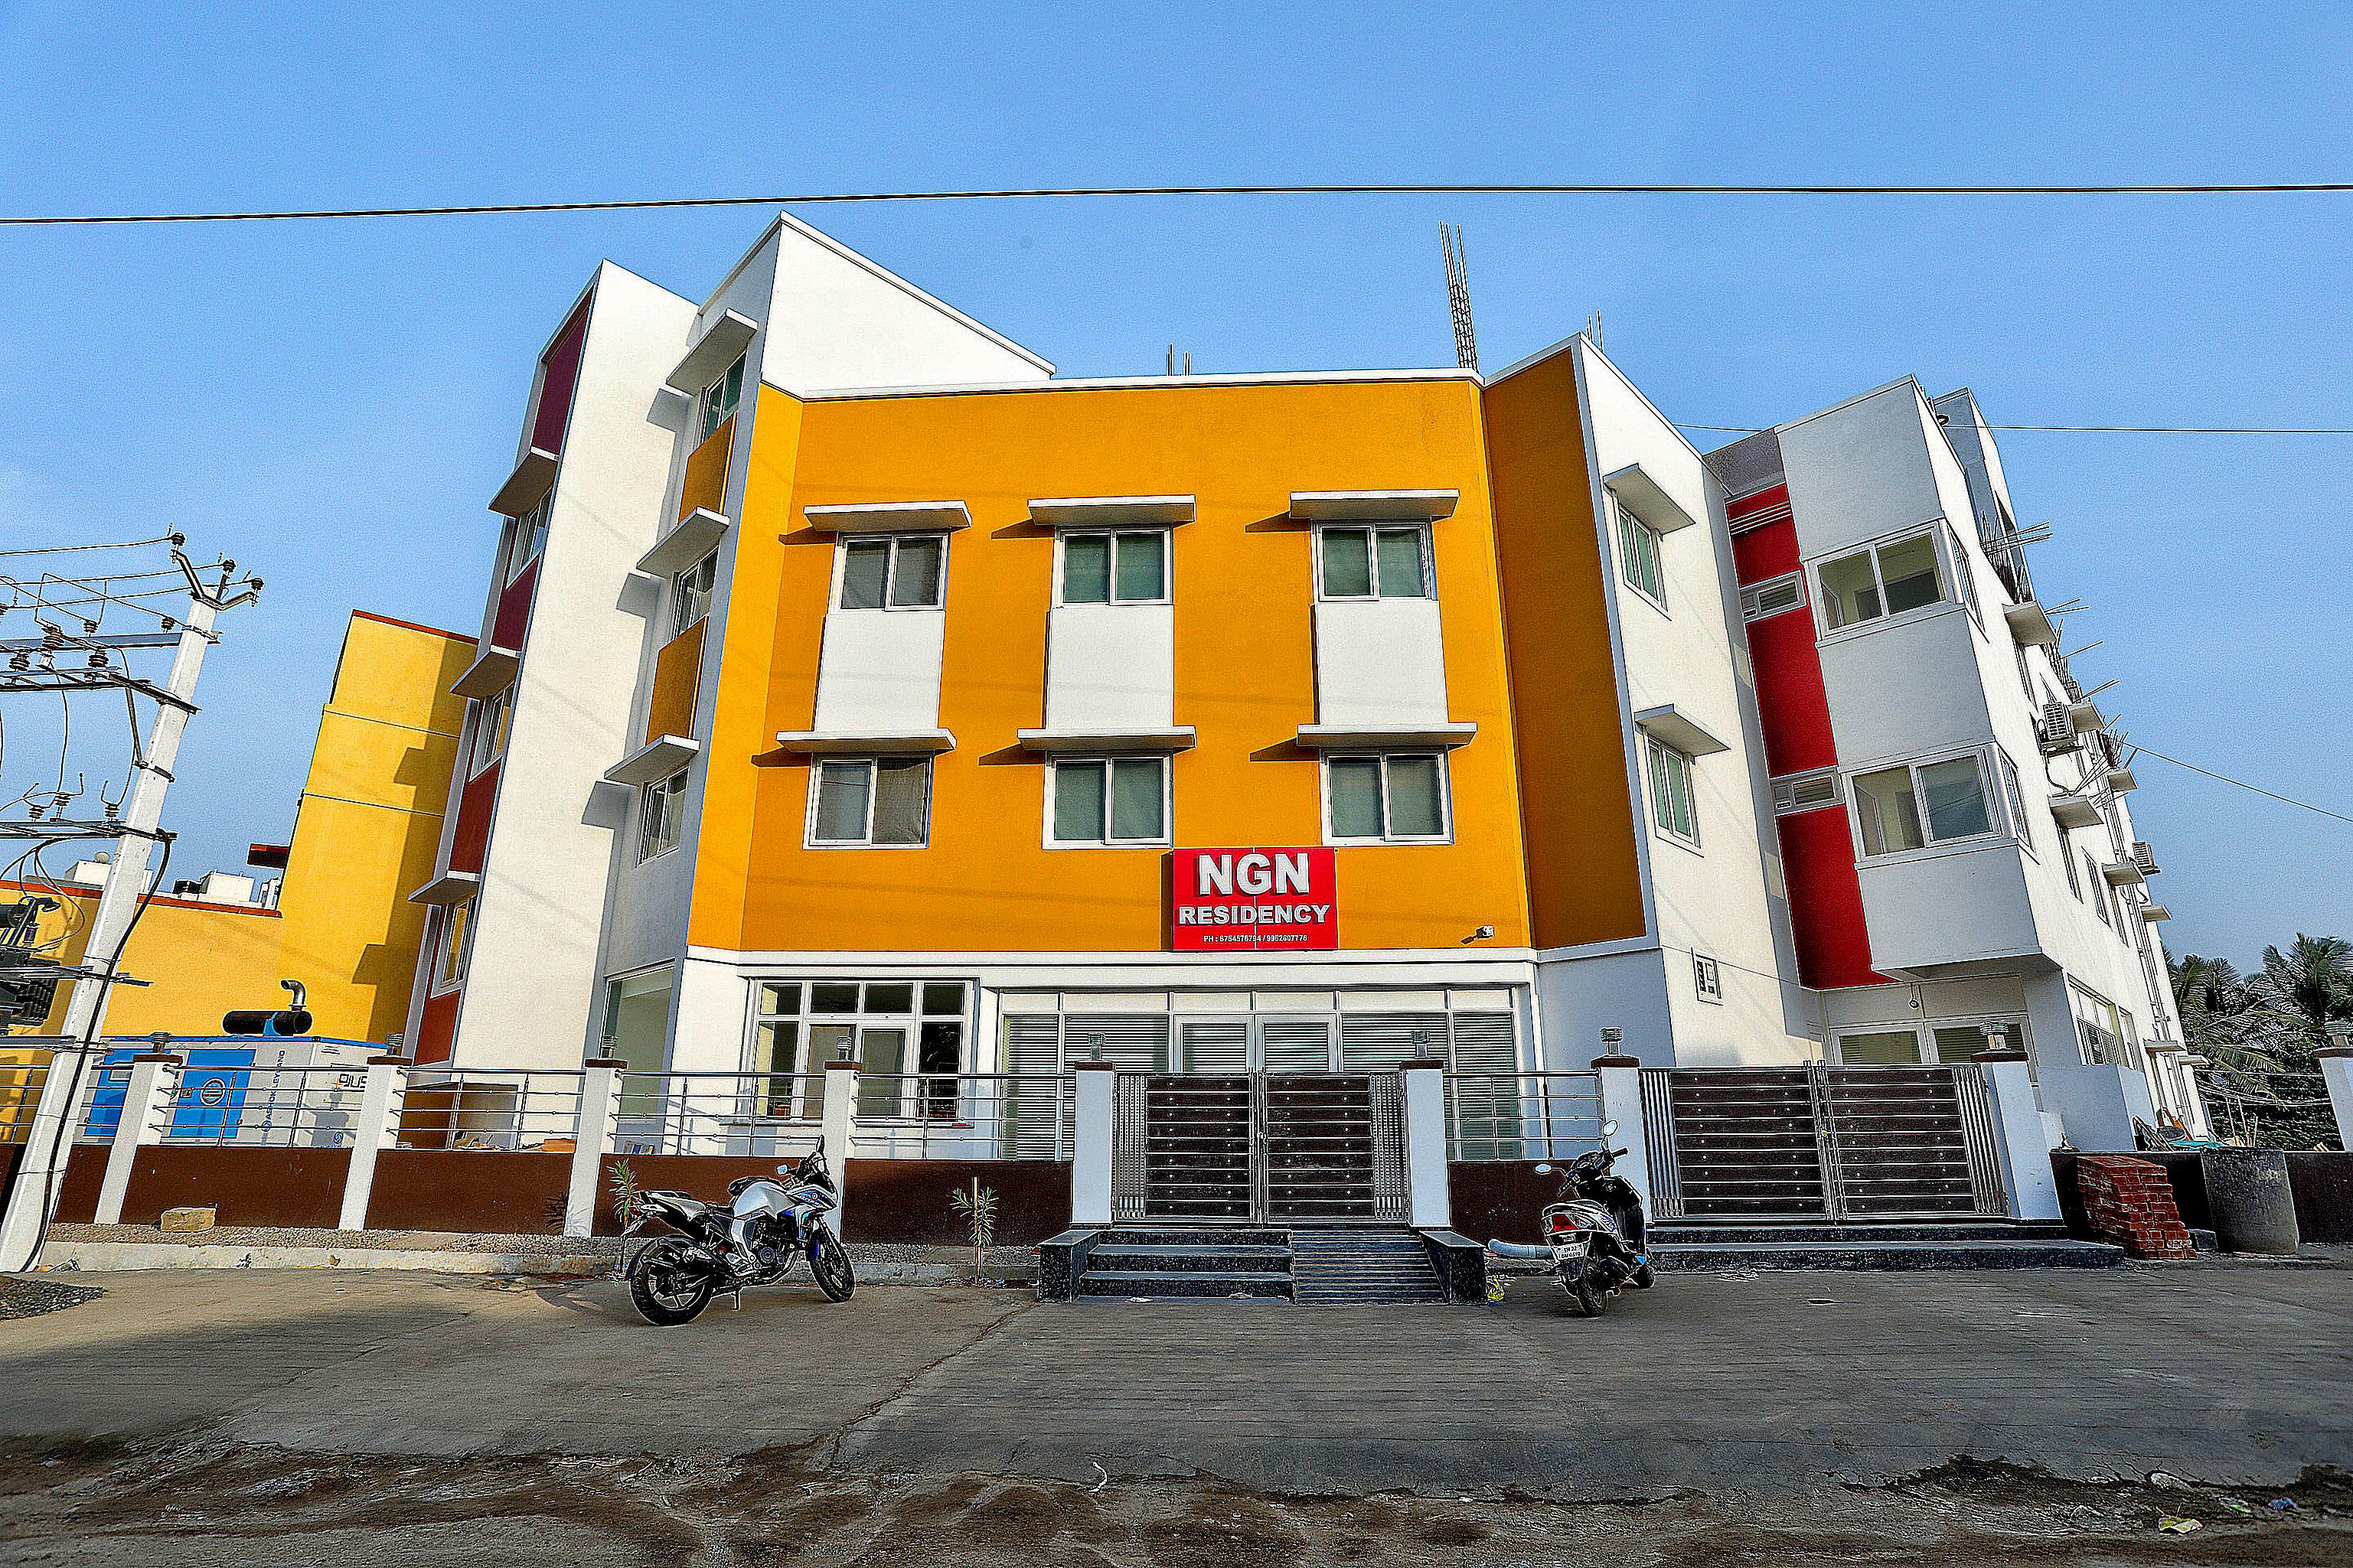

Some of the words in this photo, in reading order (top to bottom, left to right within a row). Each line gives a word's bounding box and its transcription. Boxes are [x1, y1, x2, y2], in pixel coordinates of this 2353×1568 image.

[1198, 852, 1310, 895] NGN
[1179, 905, 1330, 924] RESIDENCY
[266, 1090, 276, 1120] ASHOK
[272, 1050, 286, 1088] LEYLAND
